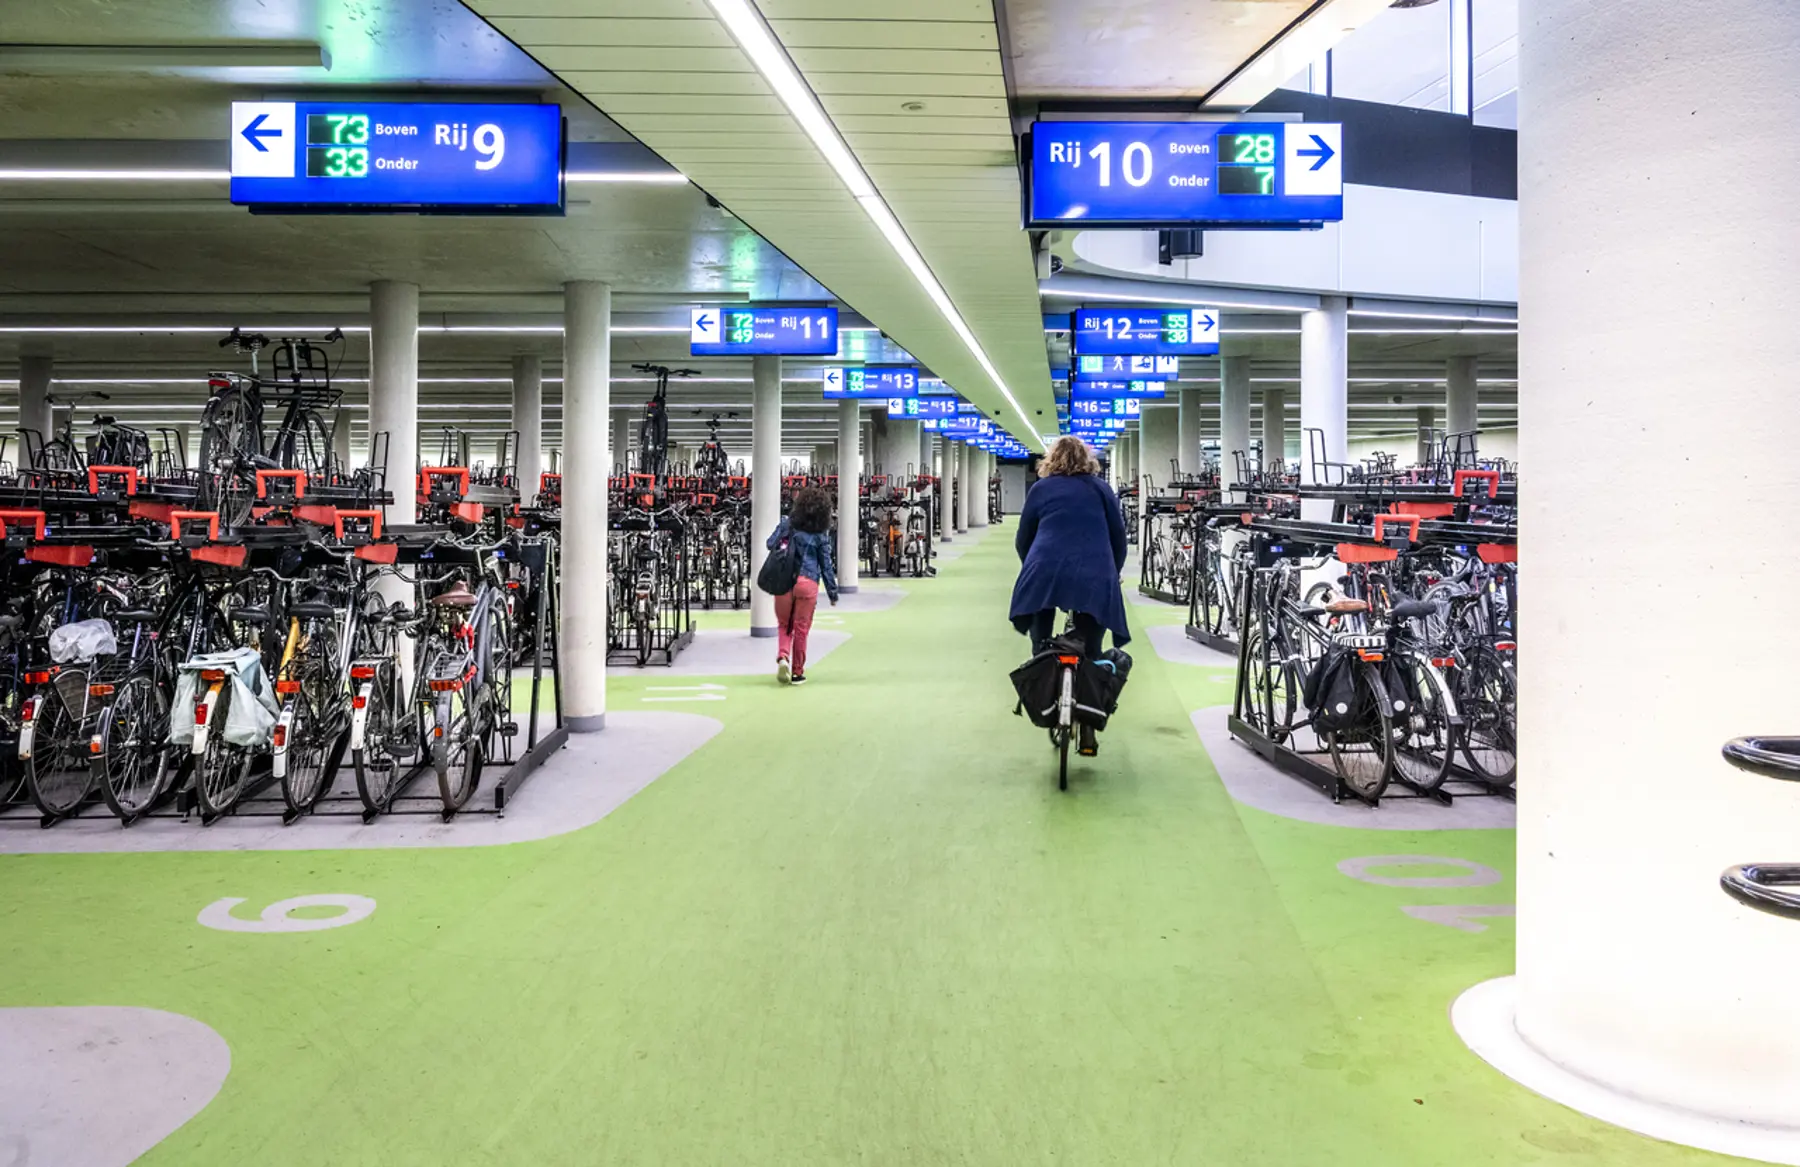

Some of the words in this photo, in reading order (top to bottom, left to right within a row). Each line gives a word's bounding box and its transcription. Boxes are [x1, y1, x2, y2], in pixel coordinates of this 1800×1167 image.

[327, 114, 369, 144] 73
[375, 123, 418, 136] Boven
[434, 123, 468, 151] Rij
[472, 123, 506, 171] 9
[1169, 142, 1210, 154] Boven
[1234, 135, 1275, 163] 28
[327, 147, 368, 177] 33
[375, 158, 419, 170] Onder
[1050, 142, 1081, 168] Rij
[1088, 141, 1153, 187] 10
[1168, 175, 1210, 187] Onder
[1254, 167, 1275, 194] 7
[733, 313, 753, 328] 72
[781, 317, 797, 330] Rij
[800, 316, 829, 339] 11
[1084, 317, 1100, 330] Rij
[1102, 317, 1132, 339] 12
[732, 329, 753, 343] 49
[894, 373, 914, 389] 13
[940, 401, 955, 412] 15
[1083, 401, 1098, 412] 16
[965, 417, 978, 427] 17
